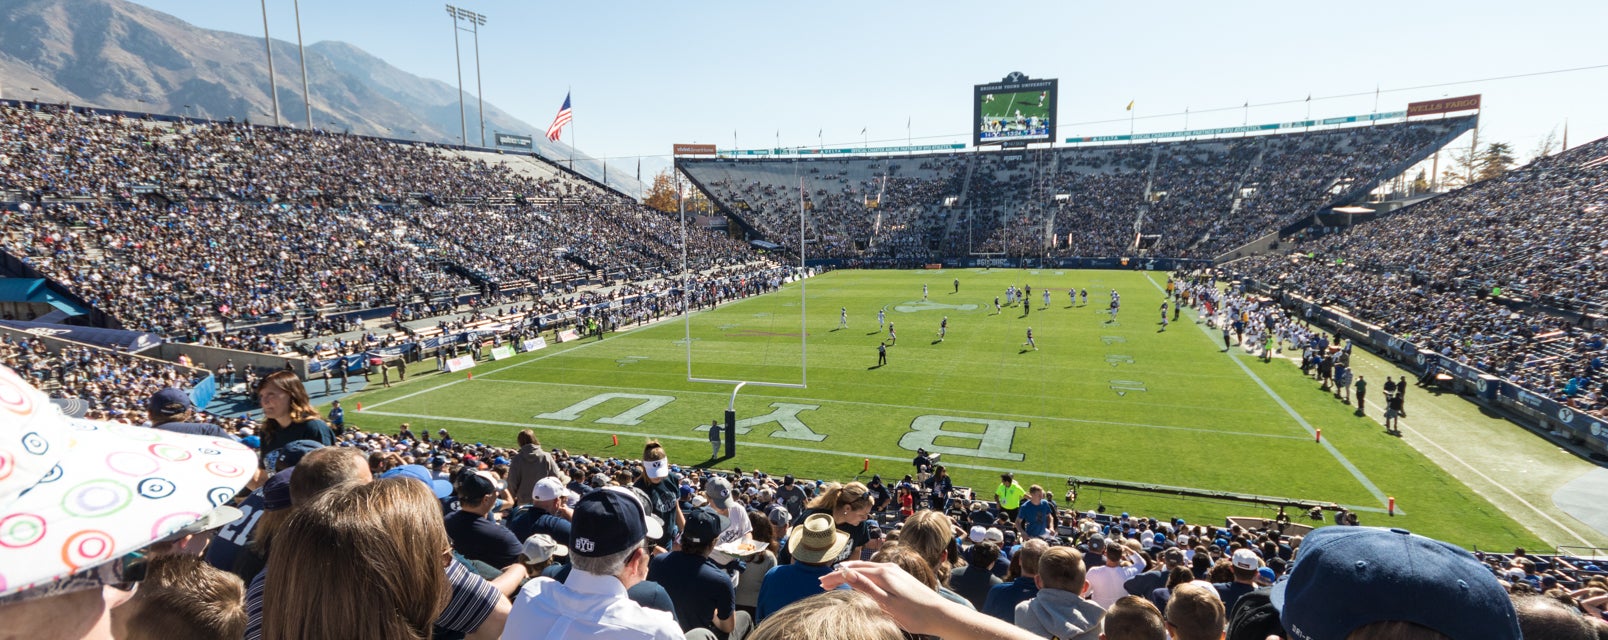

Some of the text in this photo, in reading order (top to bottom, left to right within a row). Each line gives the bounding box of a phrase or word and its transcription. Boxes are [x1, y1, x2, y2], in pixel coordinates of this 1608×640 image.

[1409, 99, 1477, 112] WELLS FARGO
[218, 504, 265, 546] 21
[575, 537, 595, 552] BYU
